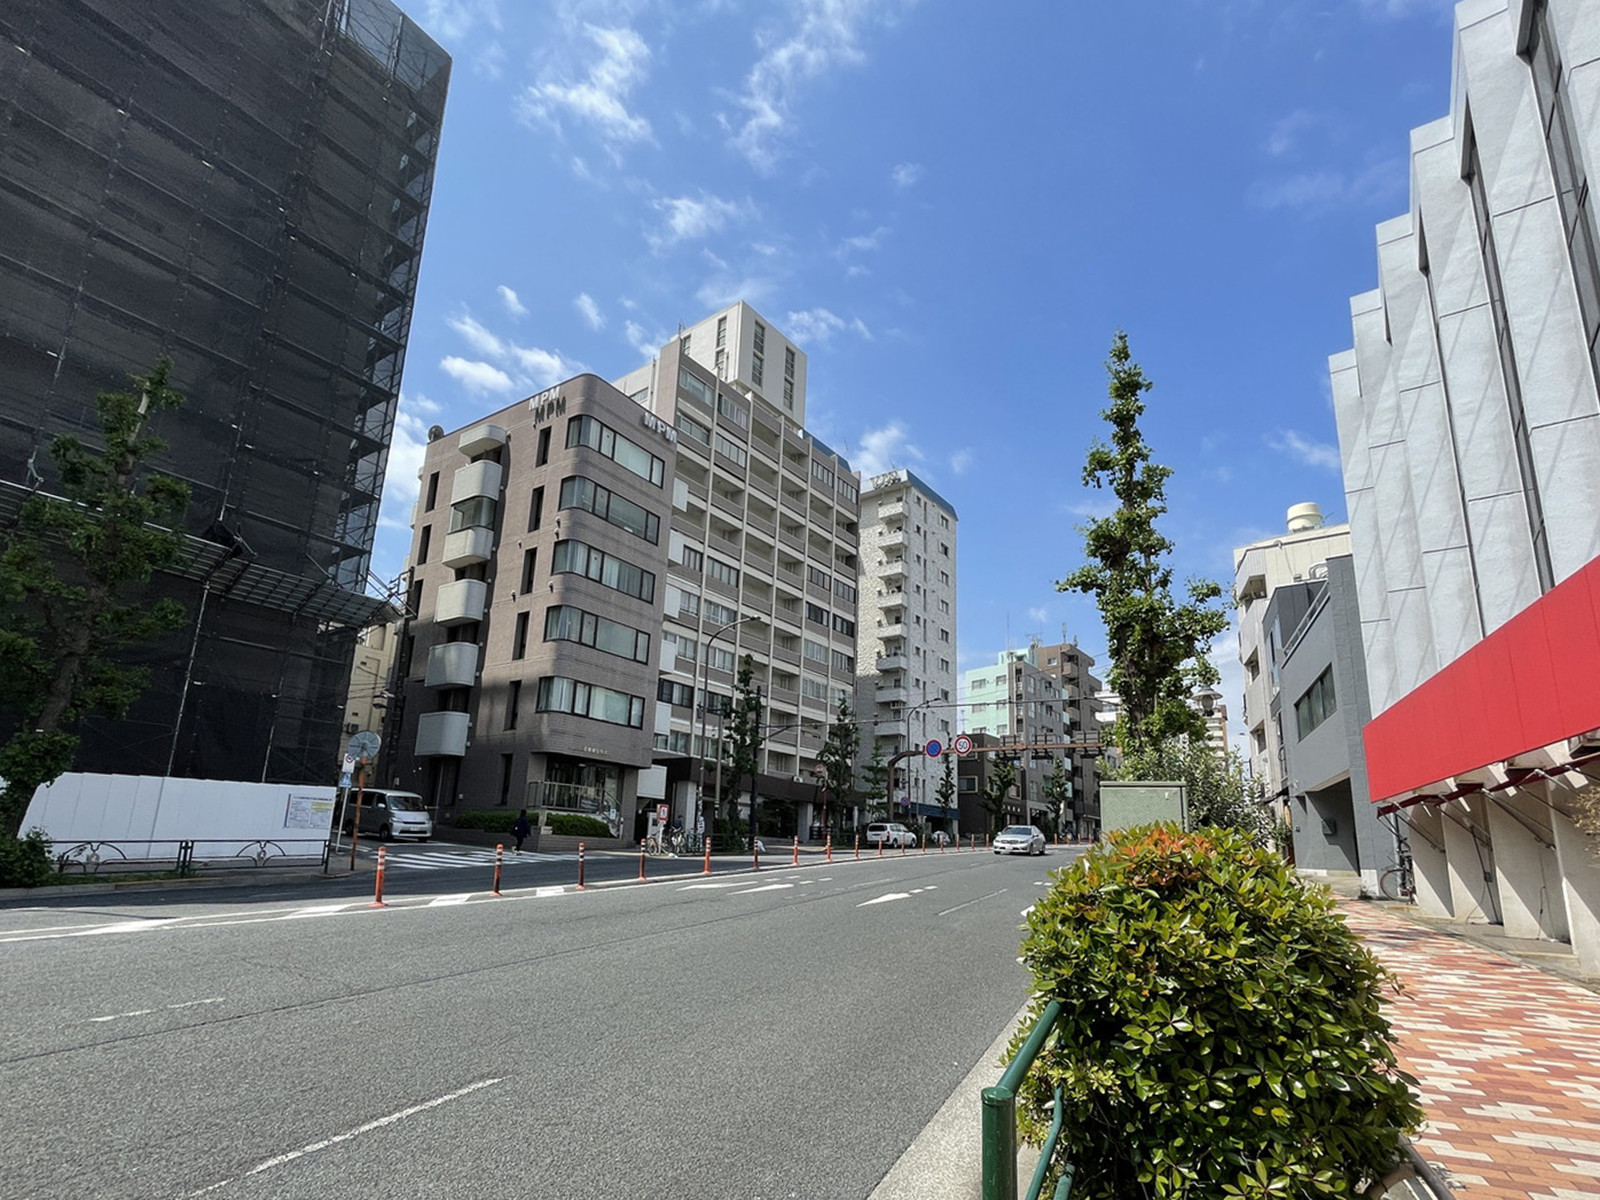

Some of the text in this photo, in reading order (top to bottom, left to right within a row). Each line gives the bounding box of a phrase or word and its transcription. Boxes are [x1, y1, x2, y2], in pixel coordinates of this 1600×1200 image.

[528, 386, 560, 411] MPM
[644, 412, 677, 443] MPM
[958, 741, 968, 750] 50
